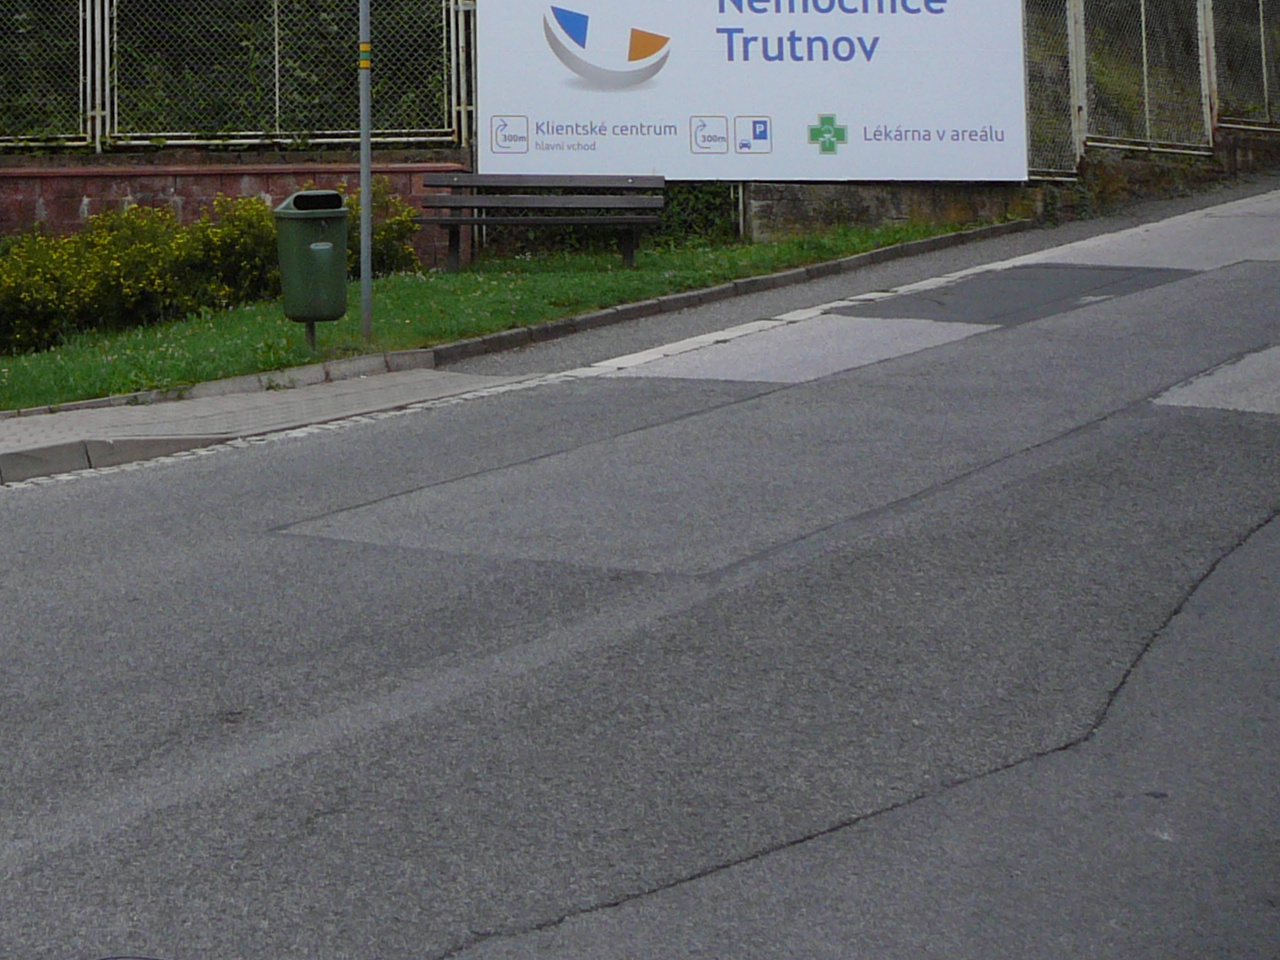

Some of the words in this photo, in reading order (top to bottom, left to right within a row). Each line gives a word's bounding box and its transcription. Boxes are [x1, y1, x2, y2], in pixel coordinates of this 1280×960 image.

[716, 27, 881, 62] Trutnov
[535, 121, 608, 136] Klientské
[612, 123, 678, 136] centrum
[755, 123, 765, 135] P
[863, 124, 932, 142] Lékárna
[936, 129, 946, 141] v
[951, 125, 1005, 142] areálu
[501, 133, 527, 143] 300m
[567, 141, 597, 151] vchod
